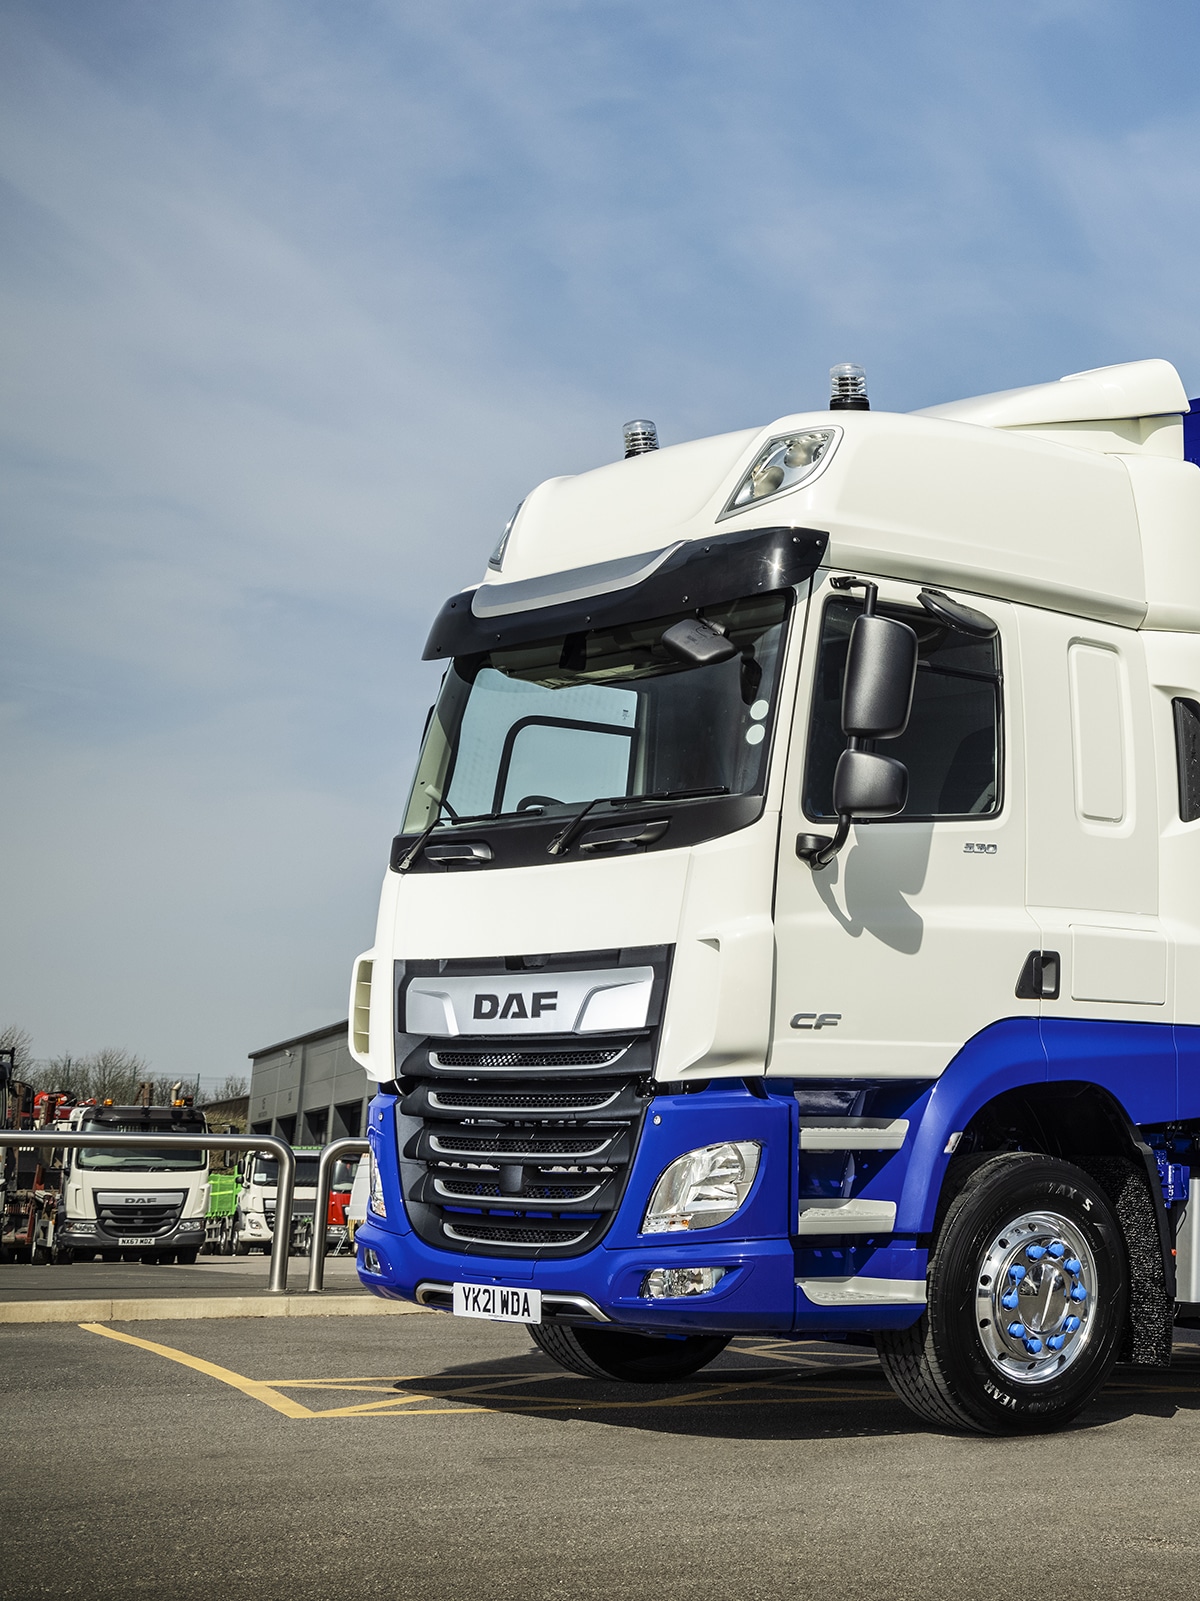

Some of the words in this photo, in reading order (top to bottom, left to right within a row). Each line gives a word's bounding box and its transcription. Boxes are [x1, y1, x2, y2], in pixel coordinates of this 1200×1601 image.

[473, 990, 558, 1019] DAF
[790, 1013, 842, 1030] CF
[463, 1286, 495, 1314] YK21
